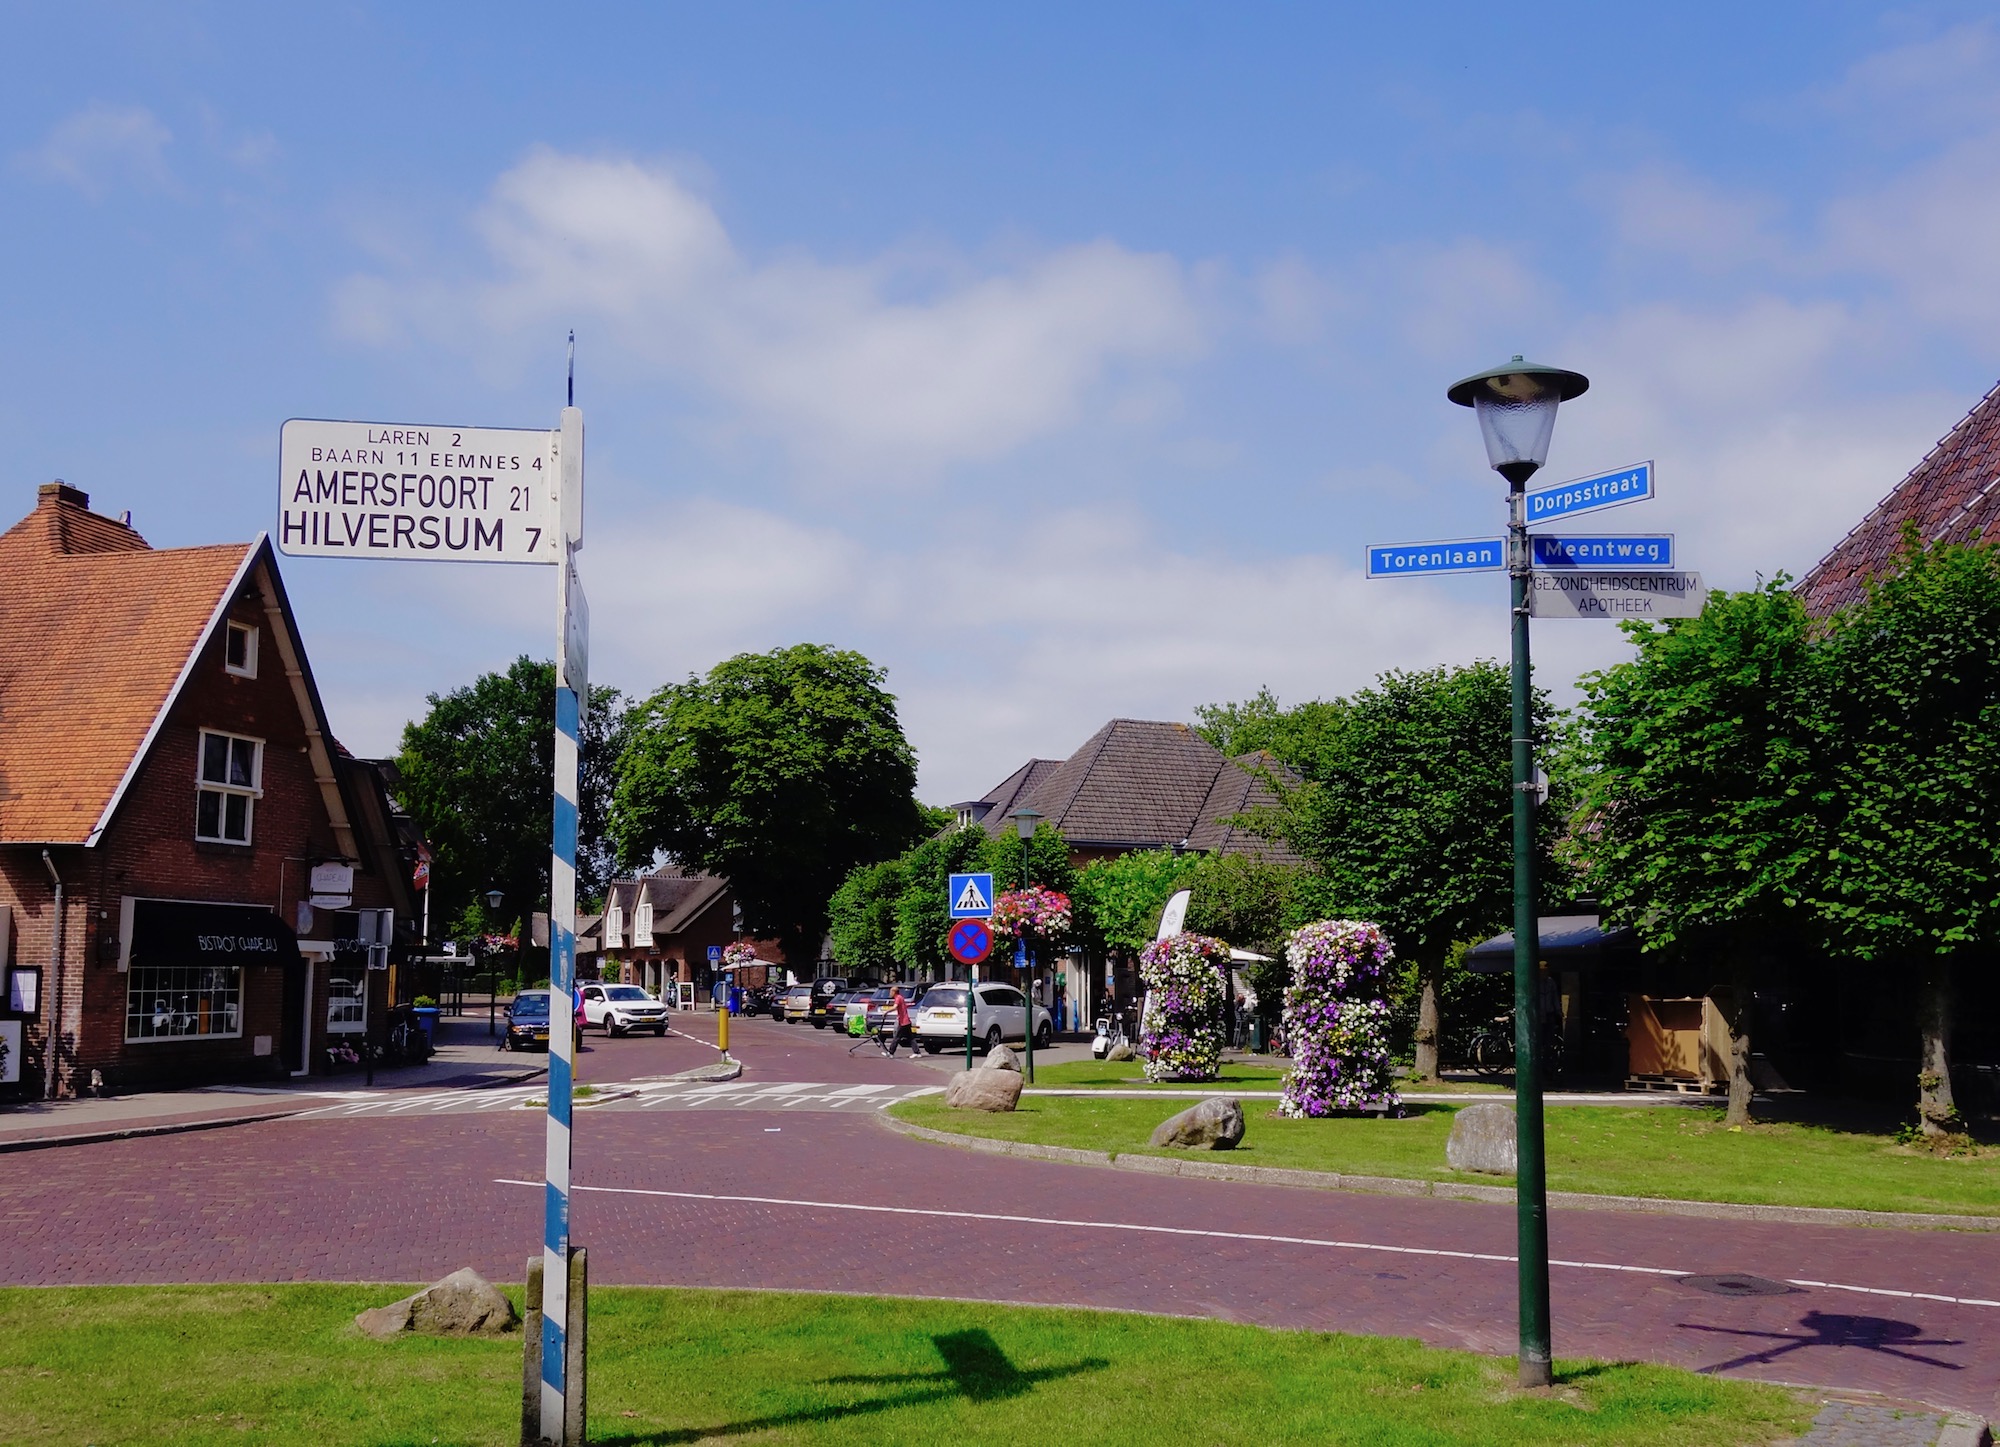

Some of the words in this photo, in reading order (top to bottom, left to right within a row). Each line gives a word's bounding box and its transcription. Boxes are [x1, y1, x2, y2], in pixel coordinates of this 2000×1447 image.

[368, 429, 430, 446] LAREN
[452, 433, 462, 447] 2
[311, 447, 384, 465] BAARN
[396, 452, 418, 467] 11
[430, 453, 520, 471] EEMNES
[532, 457, 543, 471] 4
[293, 469, 495, 511] AMERSFOORT
[509, 486, 530, 512] 21
[1534, 473, 1640, 513] Dorpsstraat
[282, 510, 503, 552] HILVERSUM
[525, 528, 542, 553] 7
[1381, 547, 1492, 568] Torenlaan
[1545, 540, 1660, 560] Meentweg
[1533, 576, 1697, 592] GEZONDHEIDSCENTRUM
[1578, 597, 1653, 613] APOTHEEK
[198, 935, 236, 953] BISTROT
[238, 936, 278, 952] CHAPEAU
